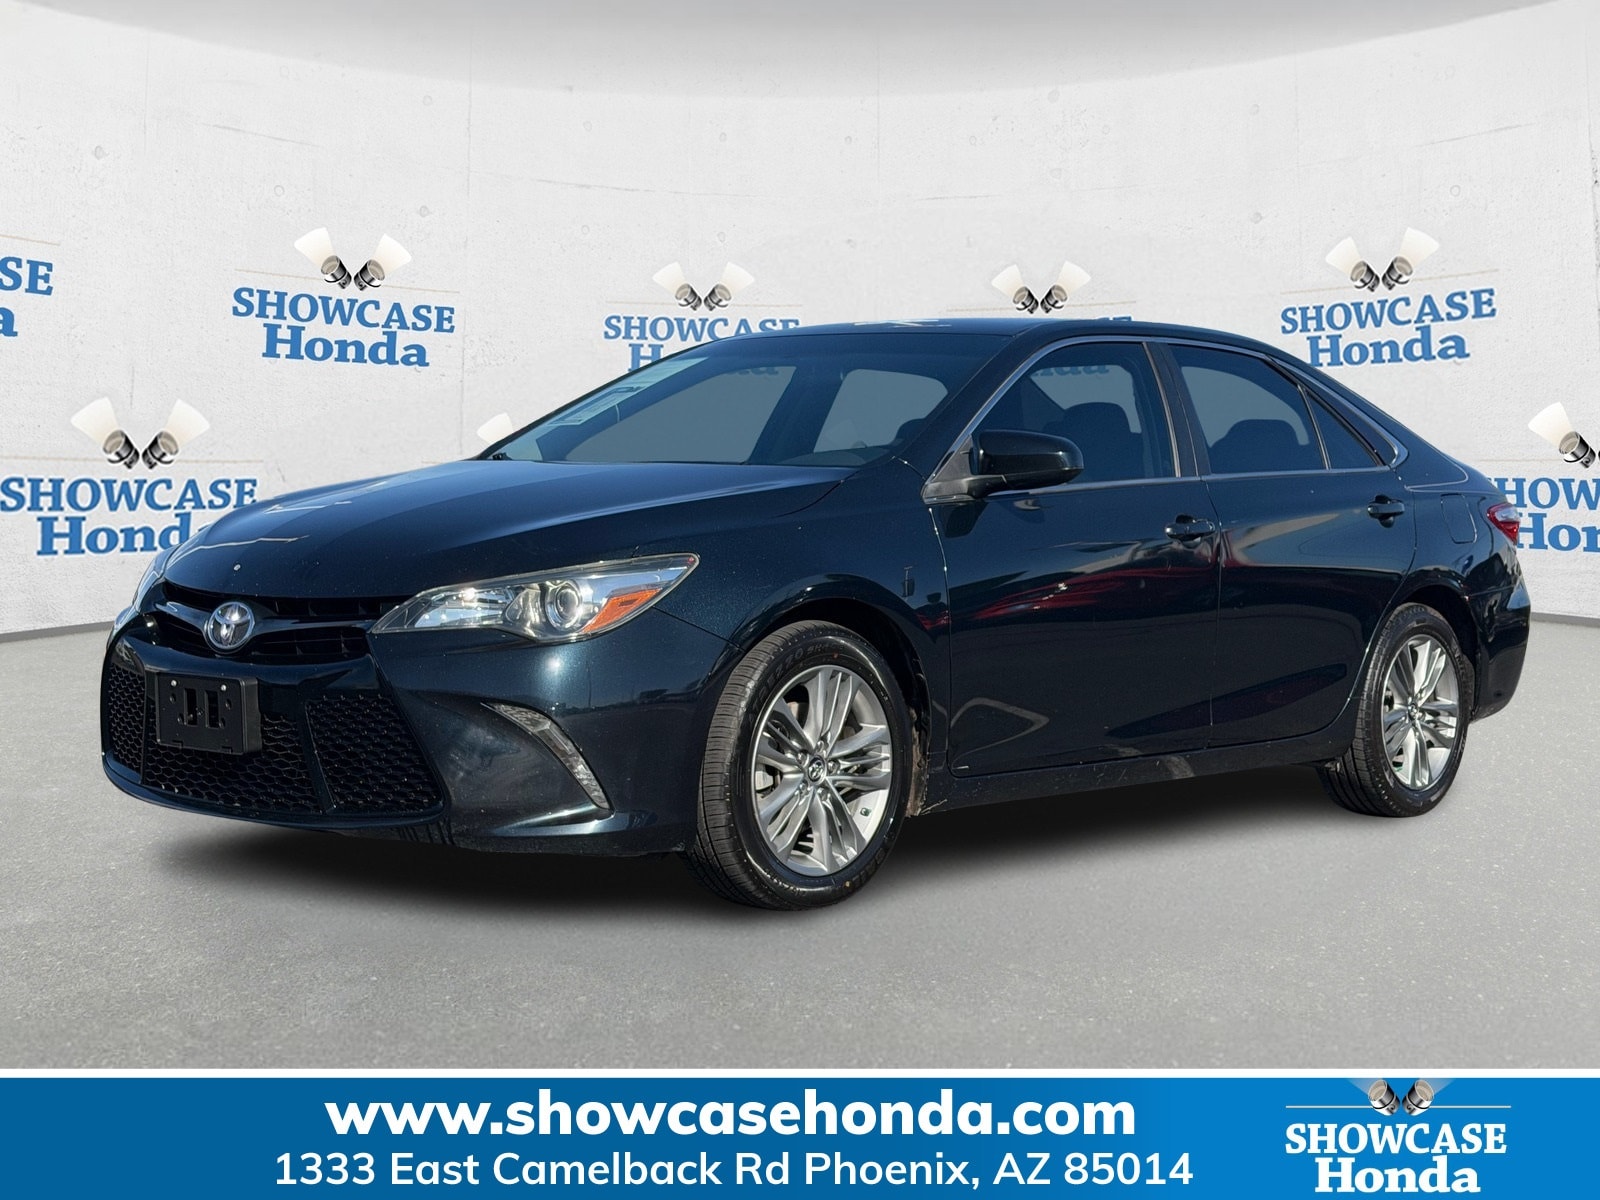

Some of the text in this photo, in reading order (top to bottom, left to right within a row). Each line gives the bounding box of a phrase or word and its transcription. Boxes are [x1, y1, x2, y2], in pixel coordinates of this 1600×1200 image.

[232, 286, 456, 334] SHOWCASE
[1281, 287, 1497, 335] SHOWCASE
[262, 322, 430, 367] Honda
[1305, 324, 1470, 368] Honda
[0, 476, 258, 512] SHOWCASE
[1488, 477, 1600, 511] HOW
[36, 511, 206, 556] Hond
